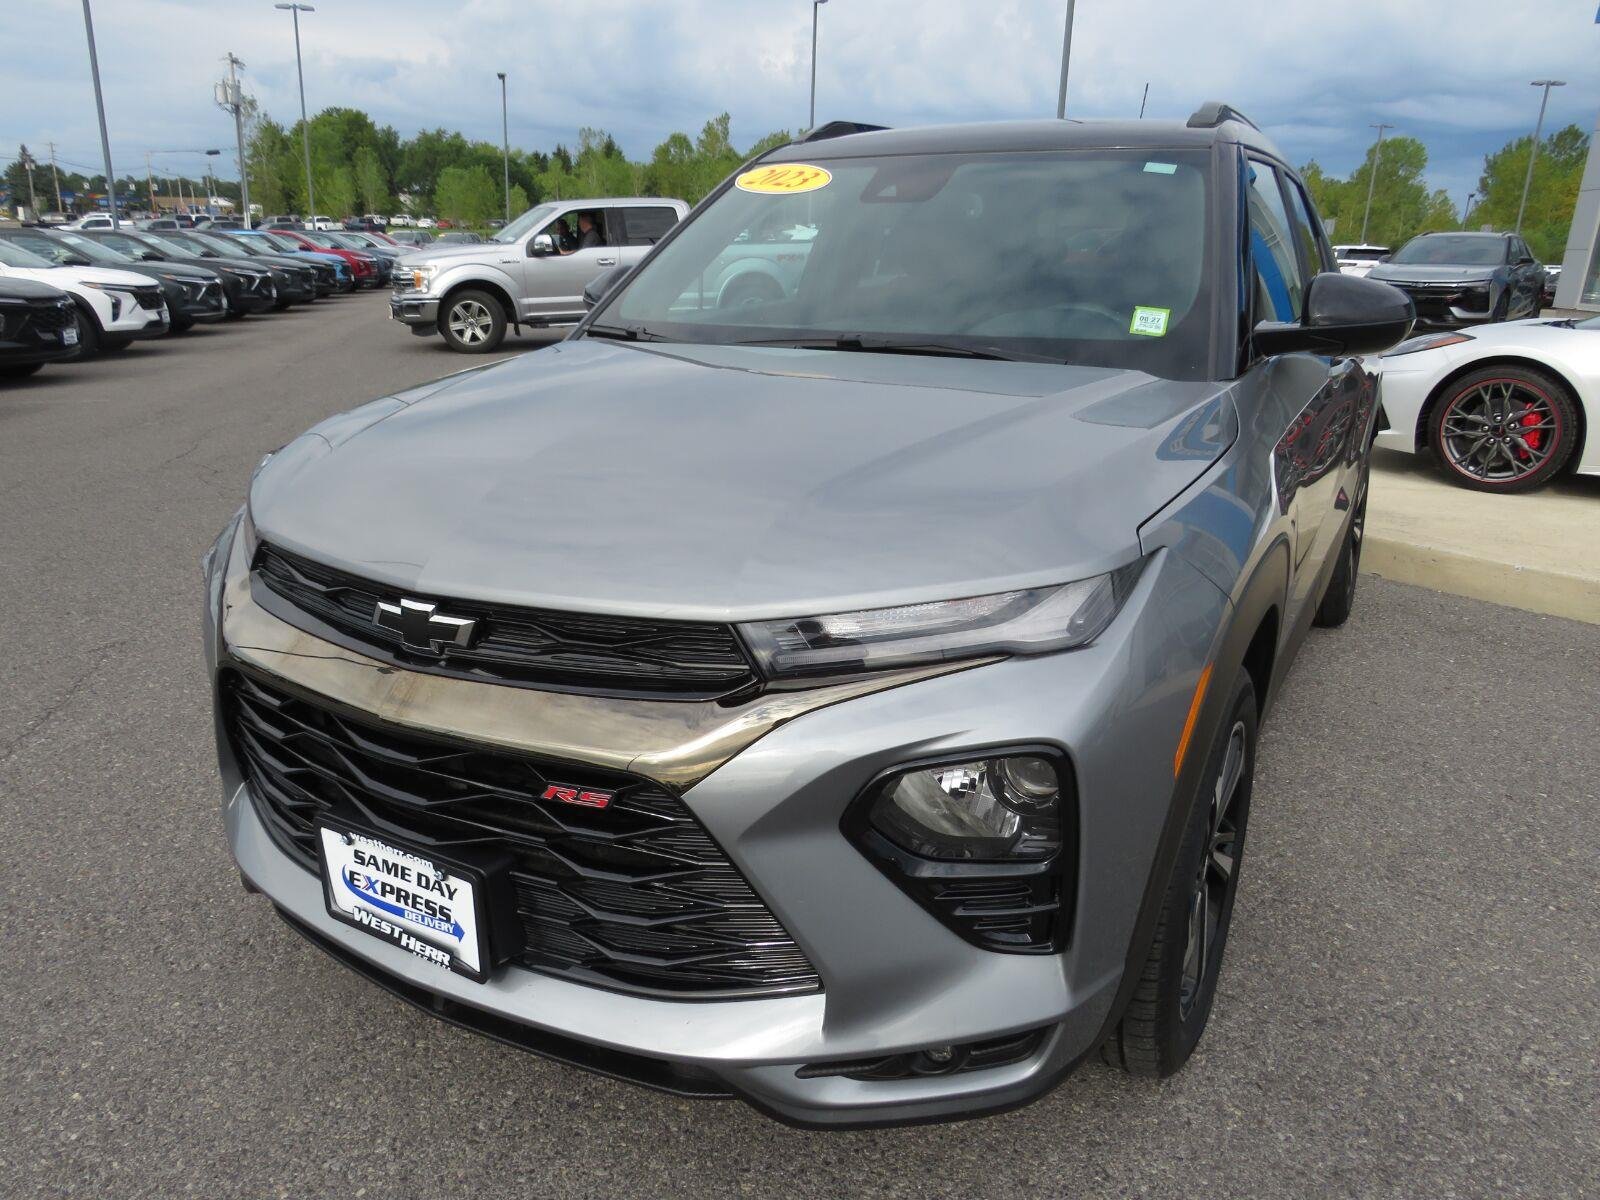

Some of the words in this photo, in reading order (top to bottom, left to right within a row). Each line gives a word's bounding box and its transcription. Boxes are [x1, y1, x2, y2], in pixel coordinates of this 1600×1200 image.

[744, 169, 821, 188] 2023
[541, 785, 612, 808] RS
[353, 849, 412, 883] SAME
[416, 871, 458, 901] DAY
[349, 870, 453, 923] EXPRESS
[352, 905, 403, 938] WEST
[400, 933, 451, 966] HERR
[404, 909, 455, 934] DELIVERY
